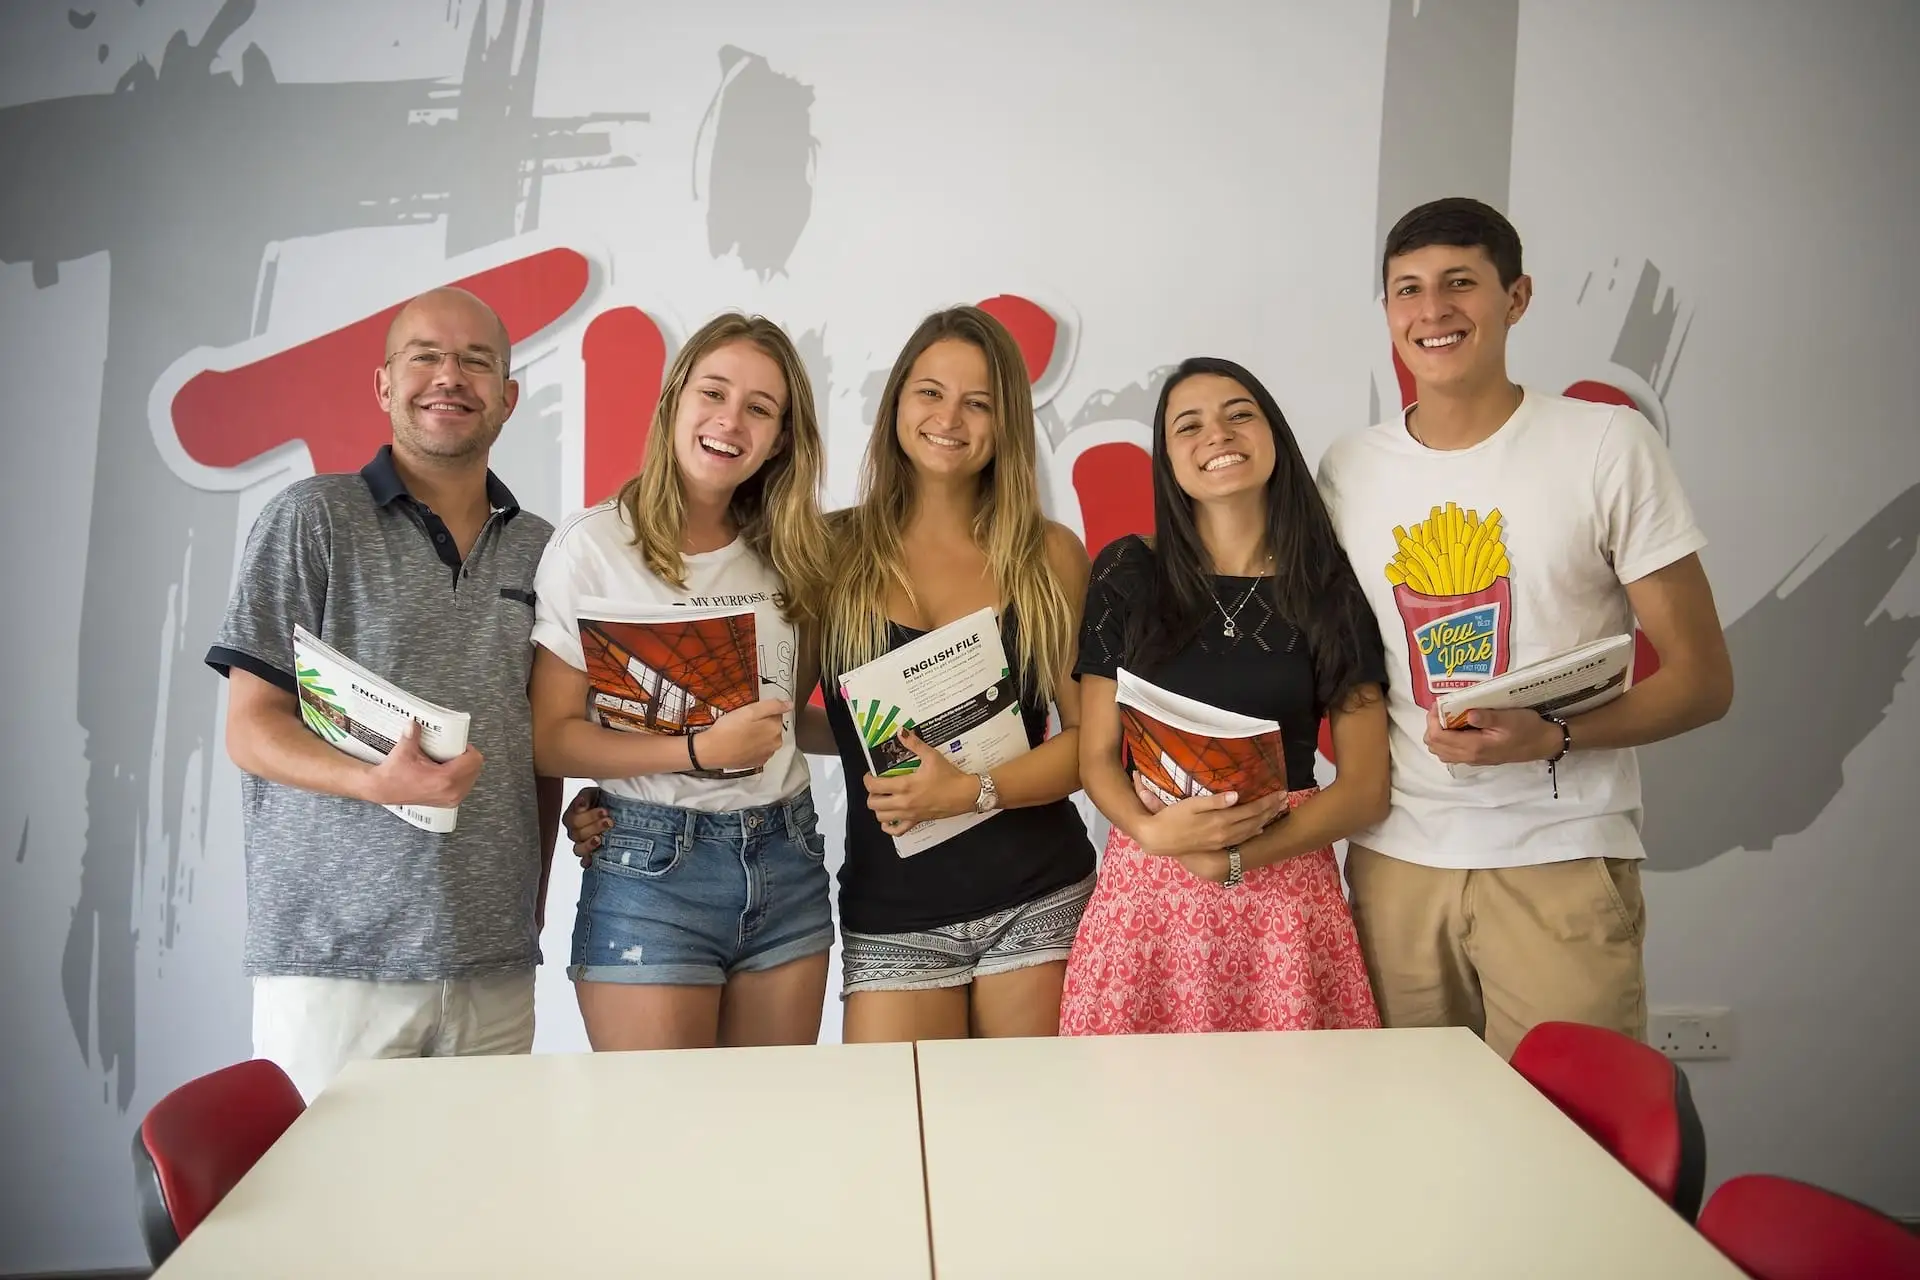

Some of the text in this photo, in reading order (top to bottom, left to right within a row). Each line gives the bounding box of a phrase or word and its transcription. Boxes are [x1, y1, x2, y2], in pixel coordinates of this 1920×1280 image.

[690, 591, 769, 607] MY PURPOSE
[902, 633, 980, 679] ENGLISH FILE
[1419, 622, 1476, 656] New
[1438, 637, 1493, 677] York
[1509, 671, 1573, 694] ENGLISH
[1577, 658, 1607, 672] FILE
[351, 683, 410, 717] ENGLISH
[413, 716, 443, 733] FILE
